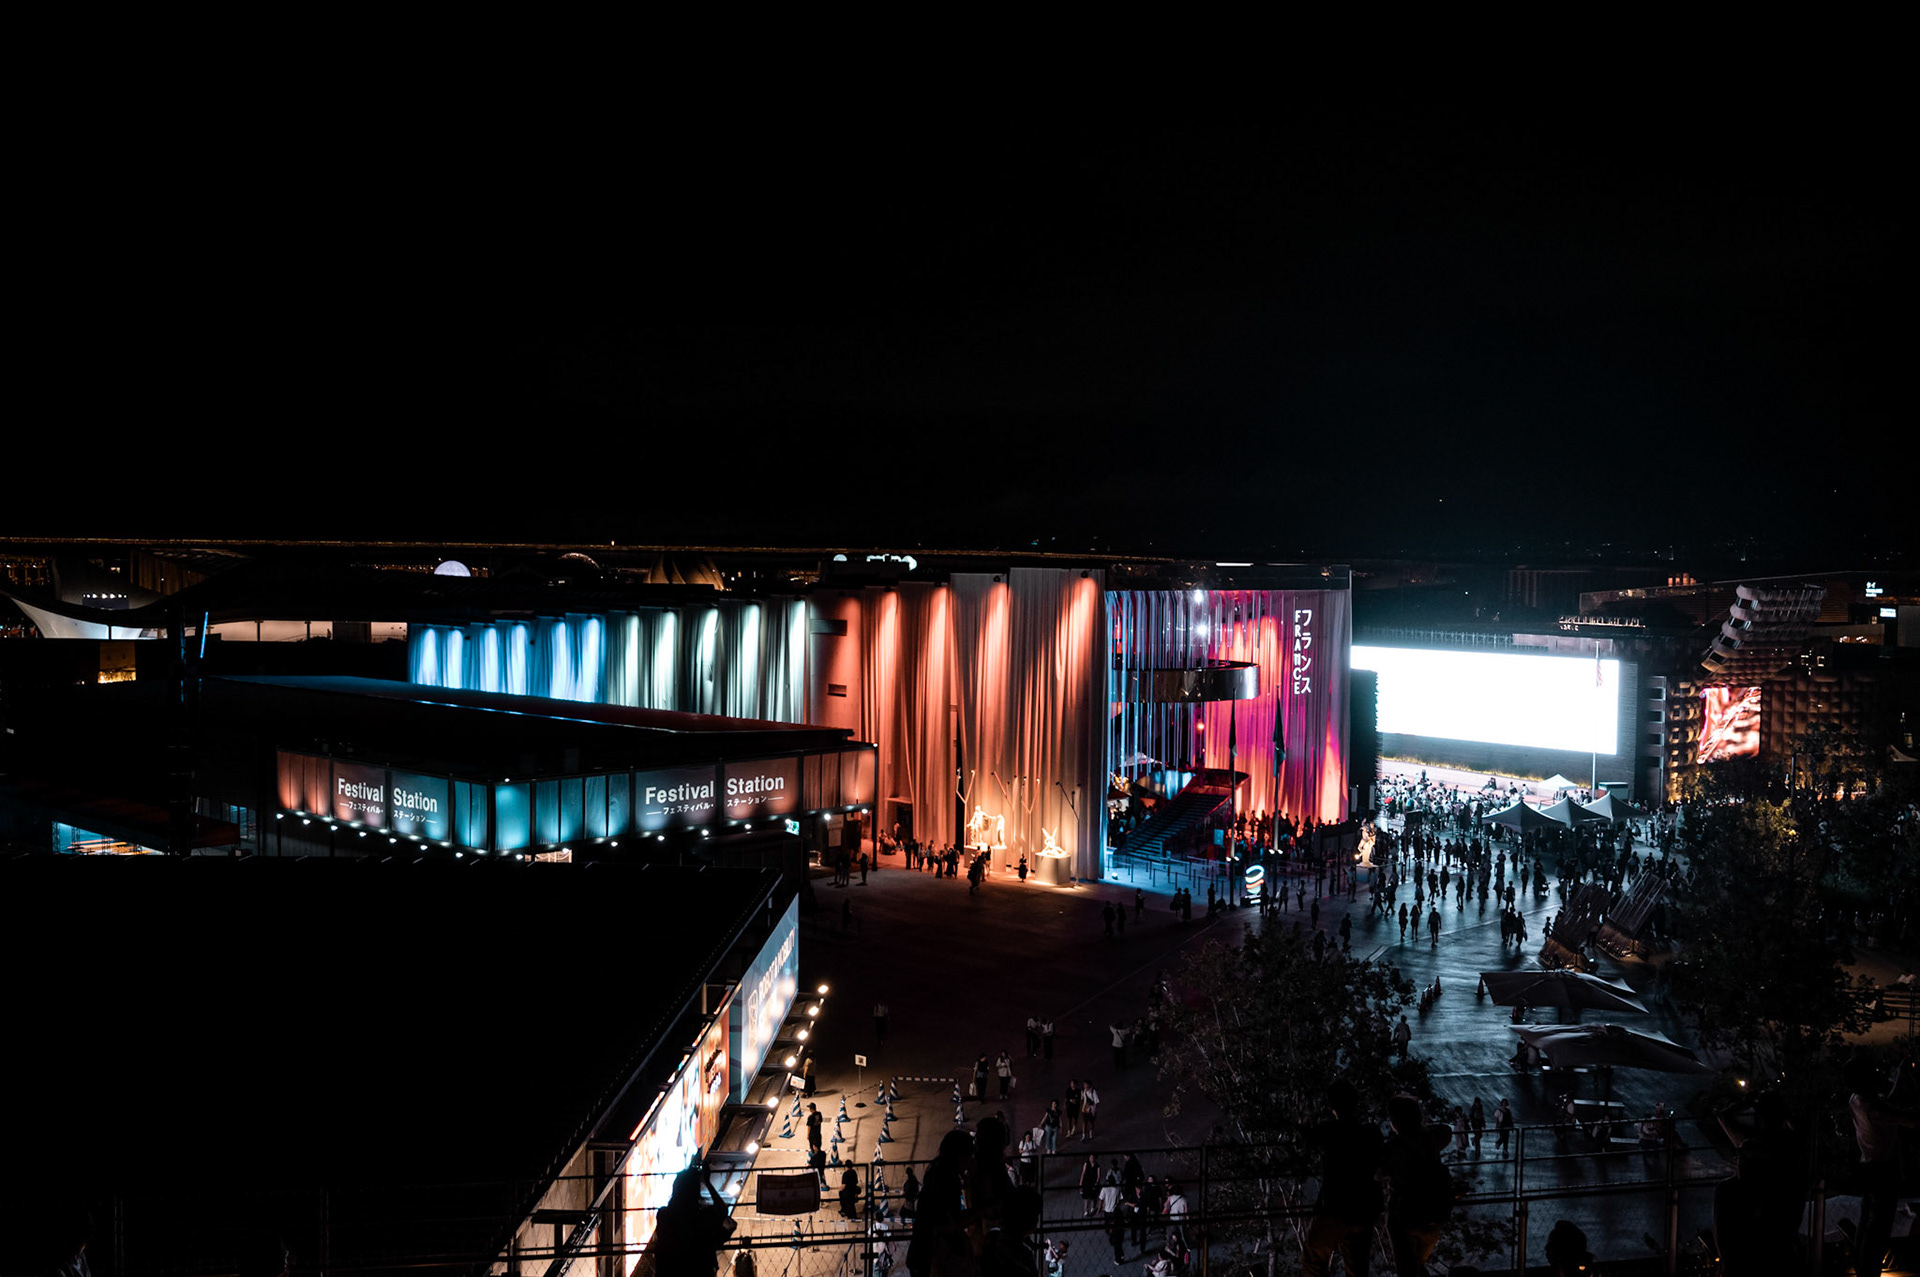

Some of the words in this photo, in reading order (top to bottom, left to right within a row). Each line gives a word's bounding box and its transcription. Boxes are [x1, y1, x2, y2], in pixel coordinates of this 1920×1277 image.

[1292, 609, 1302, 695] FRANCE
[1301, 609, 1312, 694] フランス
[338, 777, 384, 803] Festival
[393, 787, 438, 813] Station
[645, 780, 714, 805] Festival
[727, 775, 785, 796] Station
[727, 795, 767, 808] ステーション
